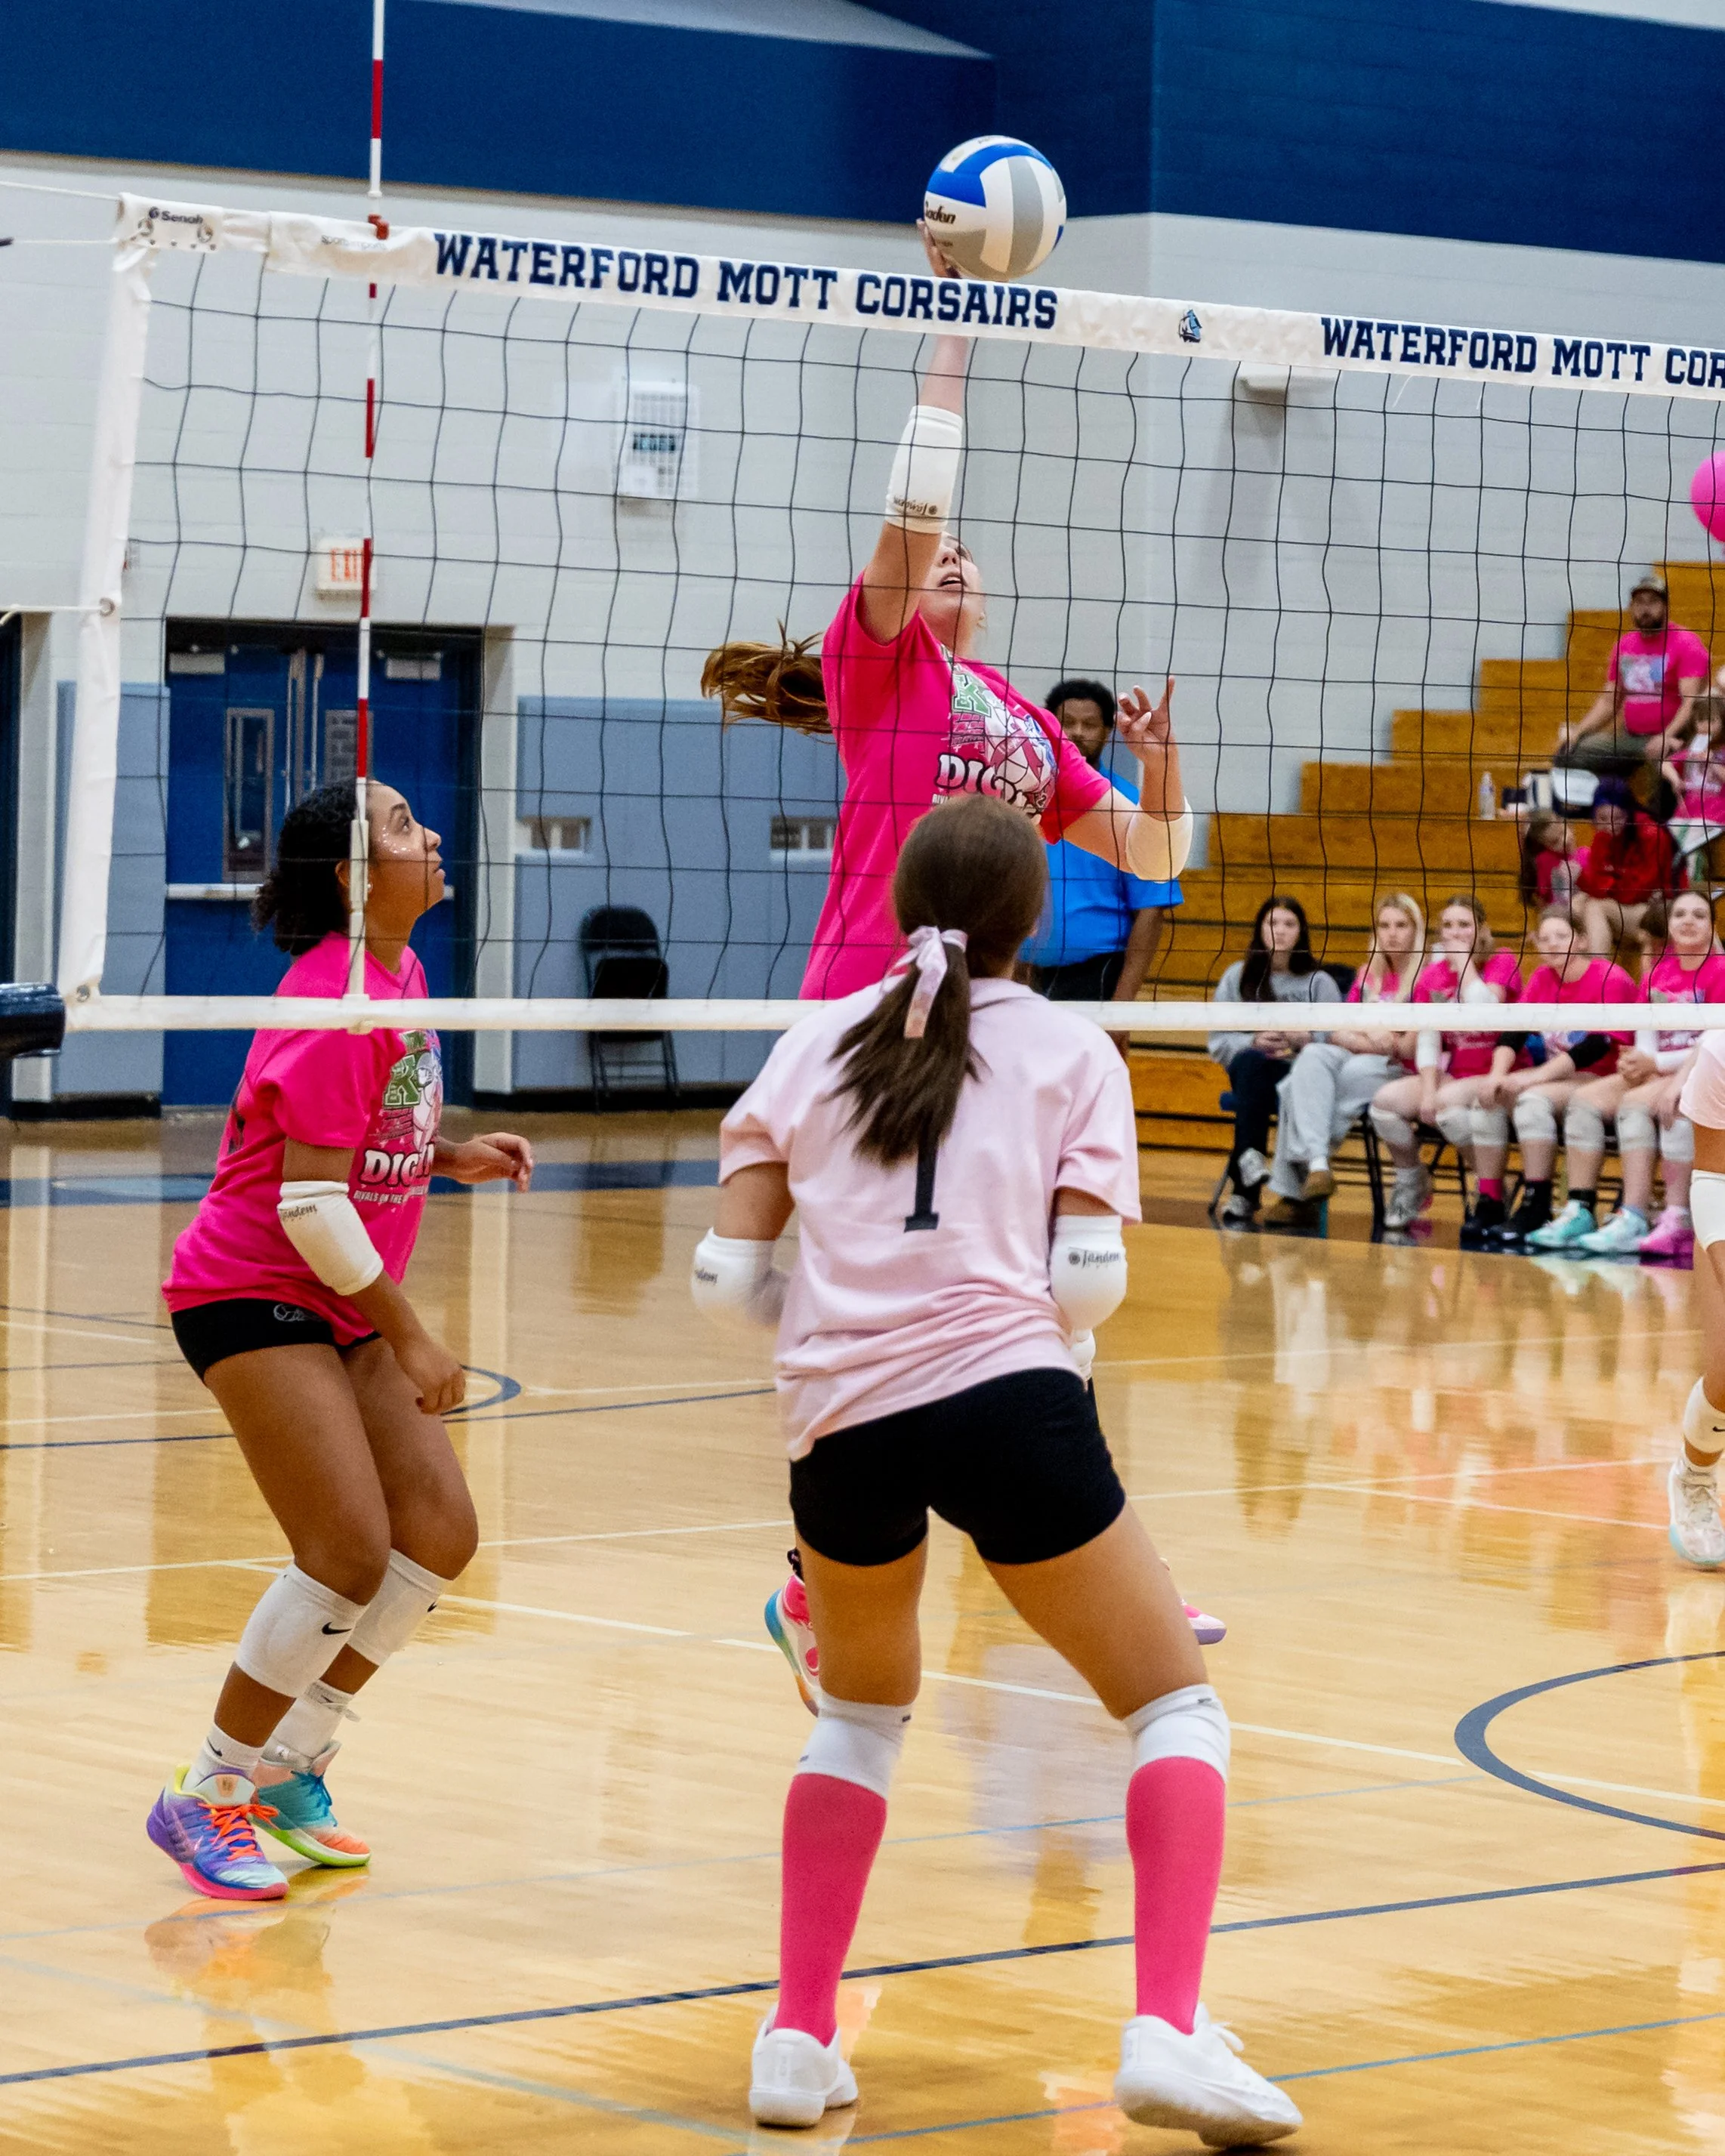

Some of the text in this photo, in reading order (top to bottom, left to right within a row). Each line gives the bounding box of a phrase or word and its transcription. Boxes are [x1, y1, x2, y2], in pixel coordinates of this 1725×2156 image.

[925, 200, 956, 224] aden
[434, 233, 1058, 330] WATERFORD MOTT CORSAIRS
[1320, 317, 1538, 373] WATERFORD
[1551, 338, 1651, 382] MOTT
